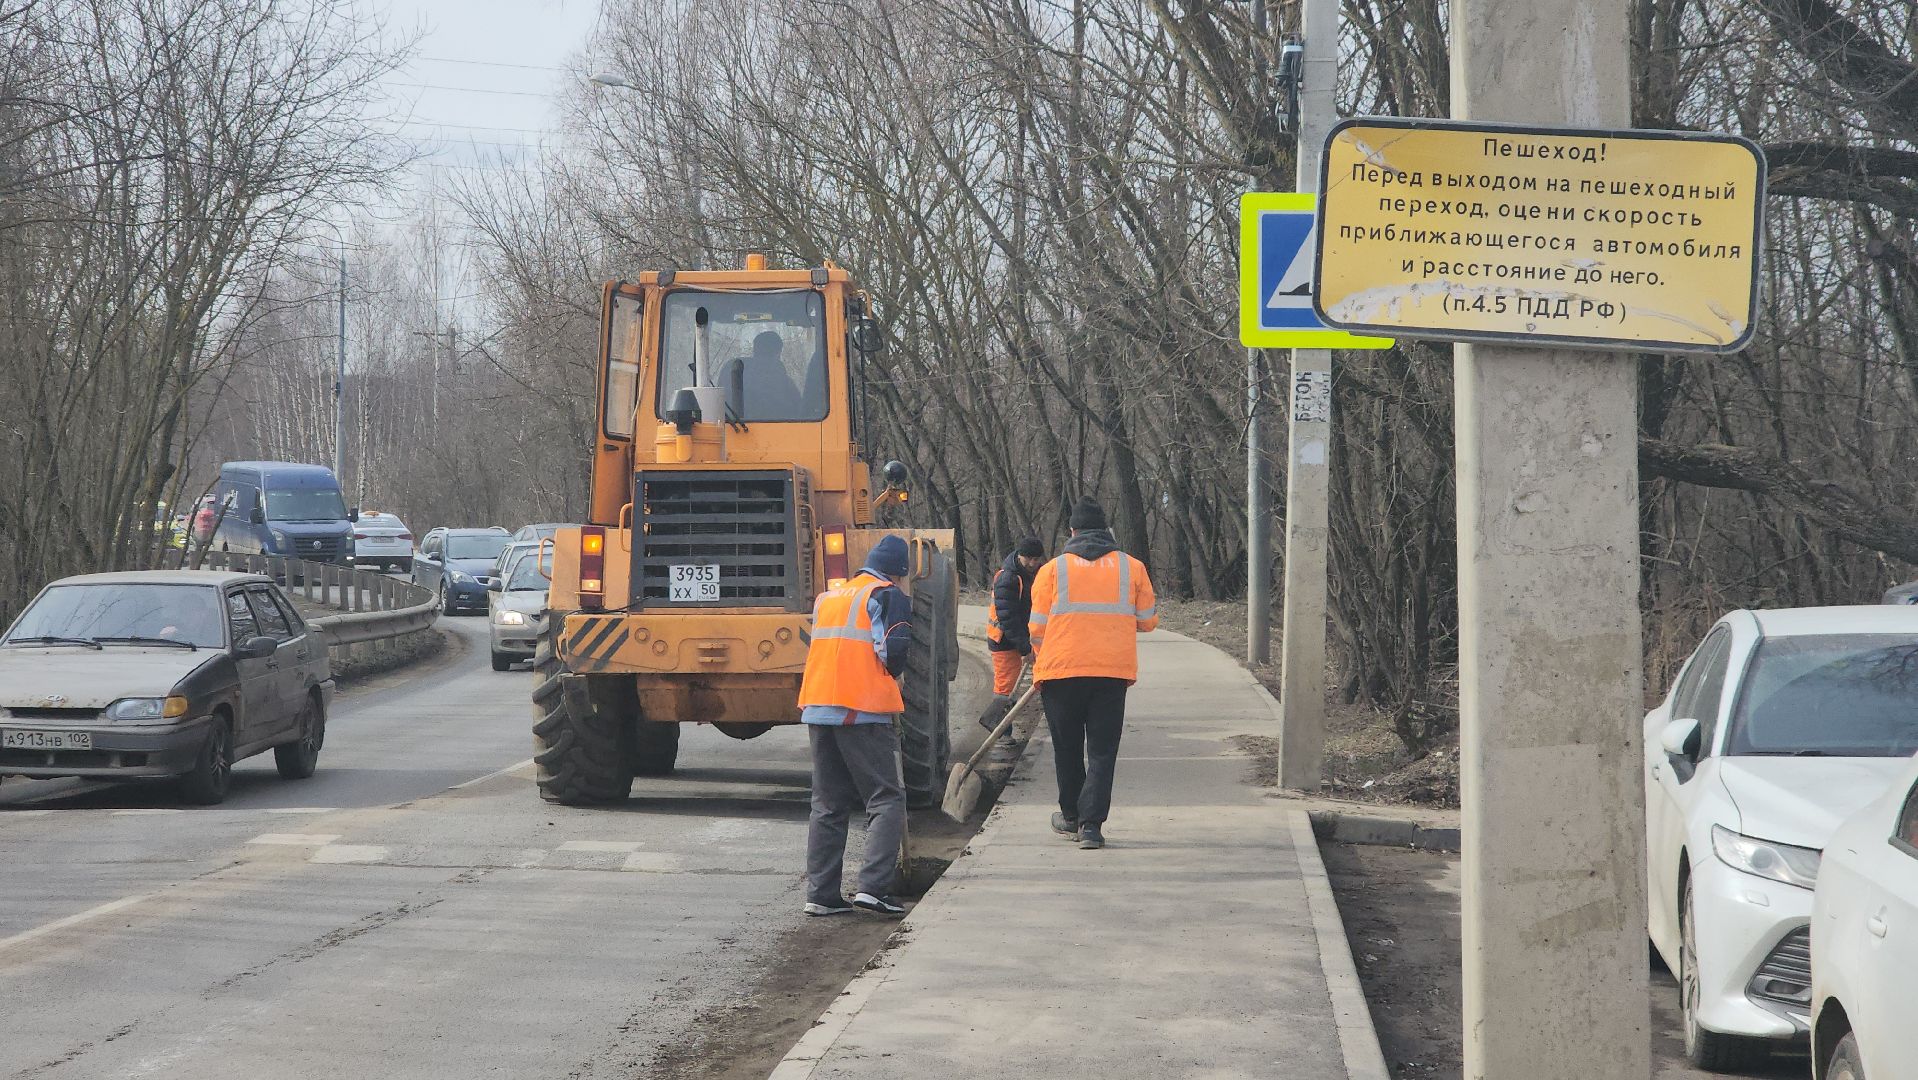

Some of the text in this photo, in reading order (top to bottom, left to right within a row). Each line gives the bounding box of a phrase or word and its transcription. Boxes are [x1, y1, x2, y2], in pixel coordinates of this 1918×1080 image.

[1483, 137, 1609, 163] Пешеход!
[1352, 163, 1736, 201] Перед выходом на пешеходный
[1379, 198, 1703, 228] переход, оцени скорость
[1340, 223, 1742, 260] приближающегося автомобиля
[1402, 259, 1666, 287] и расстояние до него.
[1443, 293, 1627, 324] (п.4.5 ПДД РФ)
[676, 567, 713, 581] 3935
[701, 584, 716, 595] 50
[67, 733, 89, 743] 102
